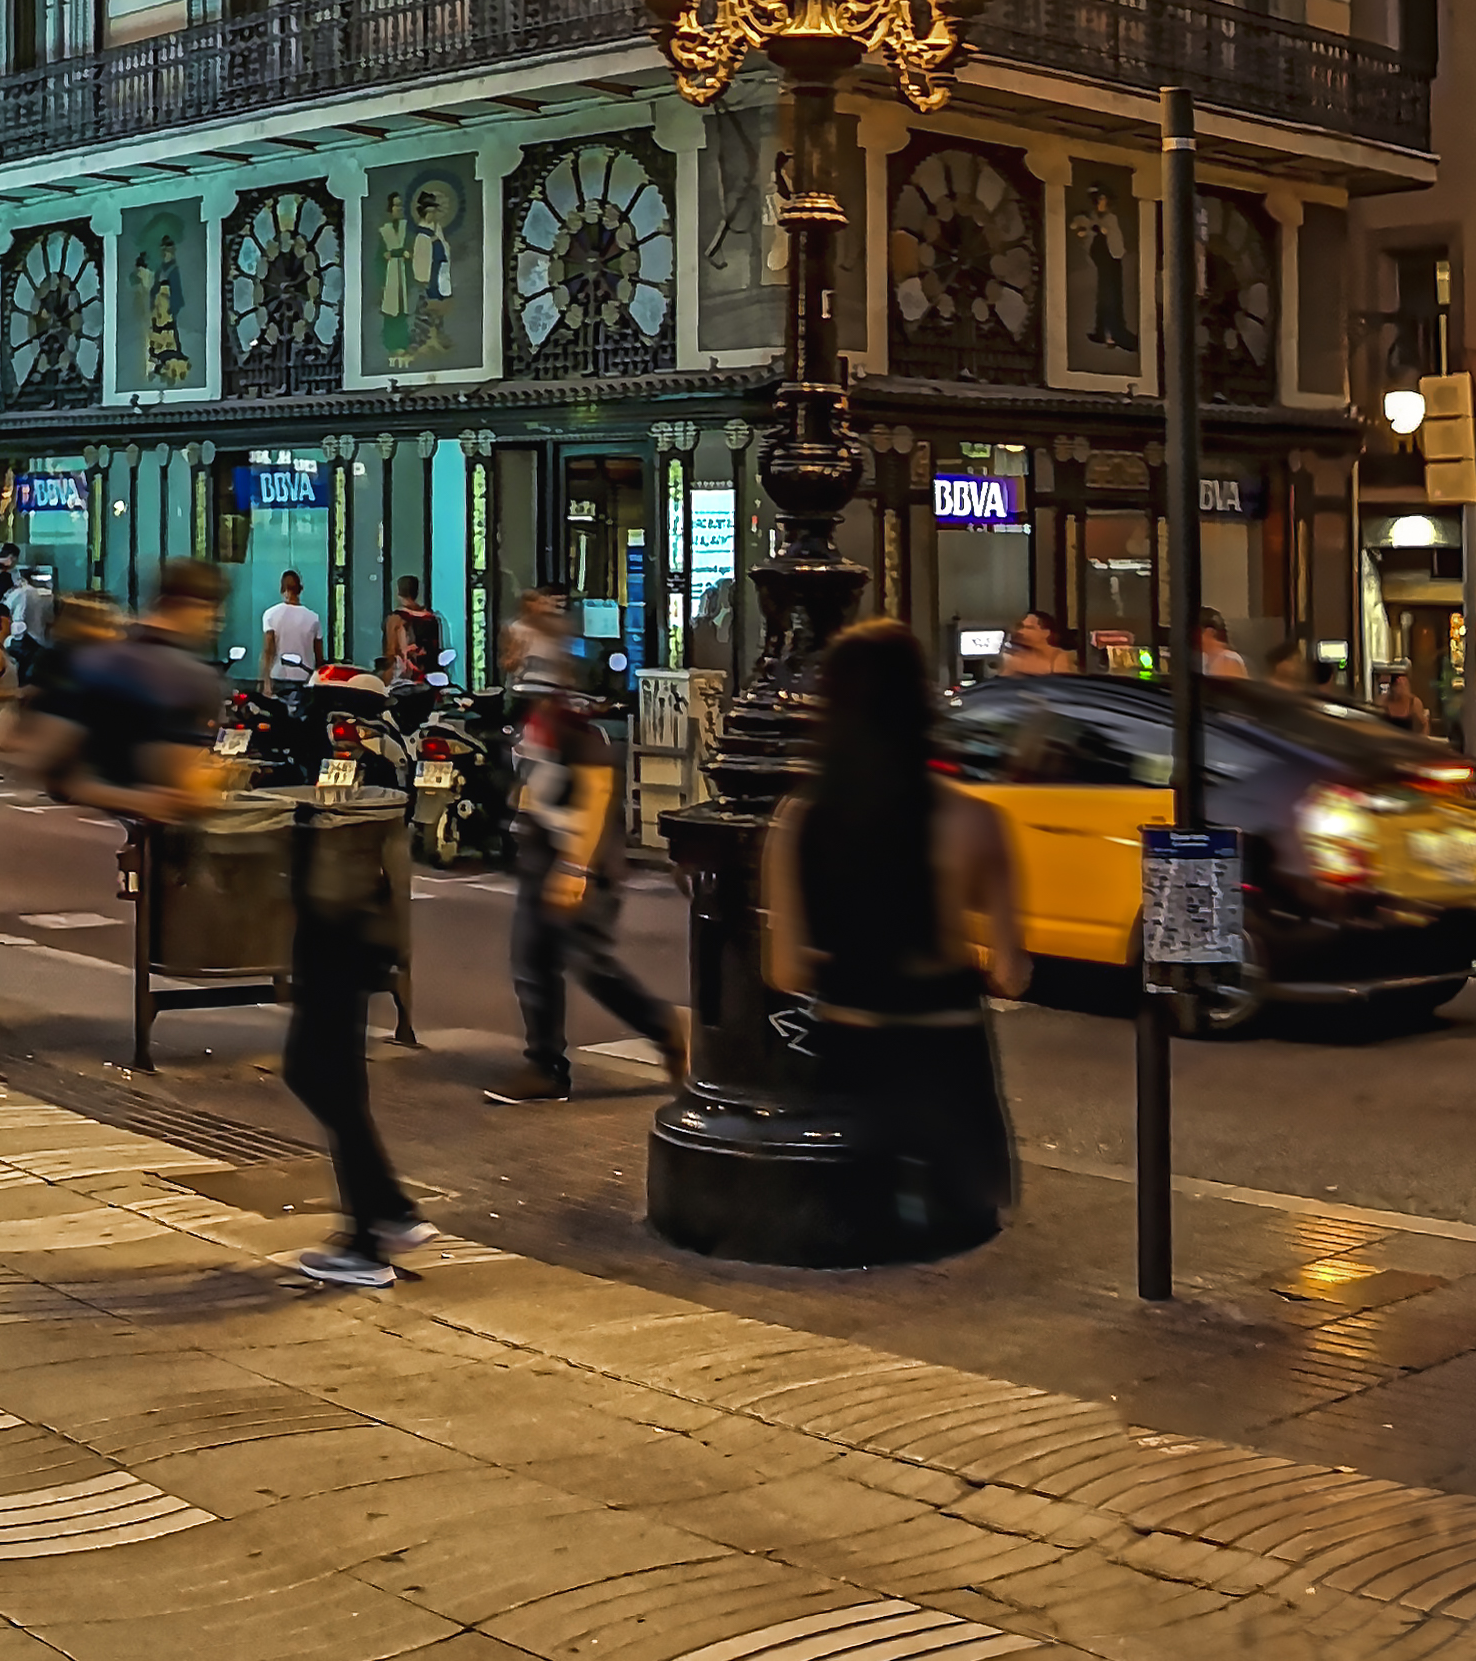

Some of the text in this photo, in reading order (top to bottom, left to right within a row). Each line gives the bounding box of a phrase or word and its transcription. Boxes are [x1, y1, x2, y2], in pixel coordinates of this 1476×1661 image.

[259, 471, 316, 503] BBVA
[934, 479, 1008, 517] BBVA
[1199, 479, 1242, 512] BVA
